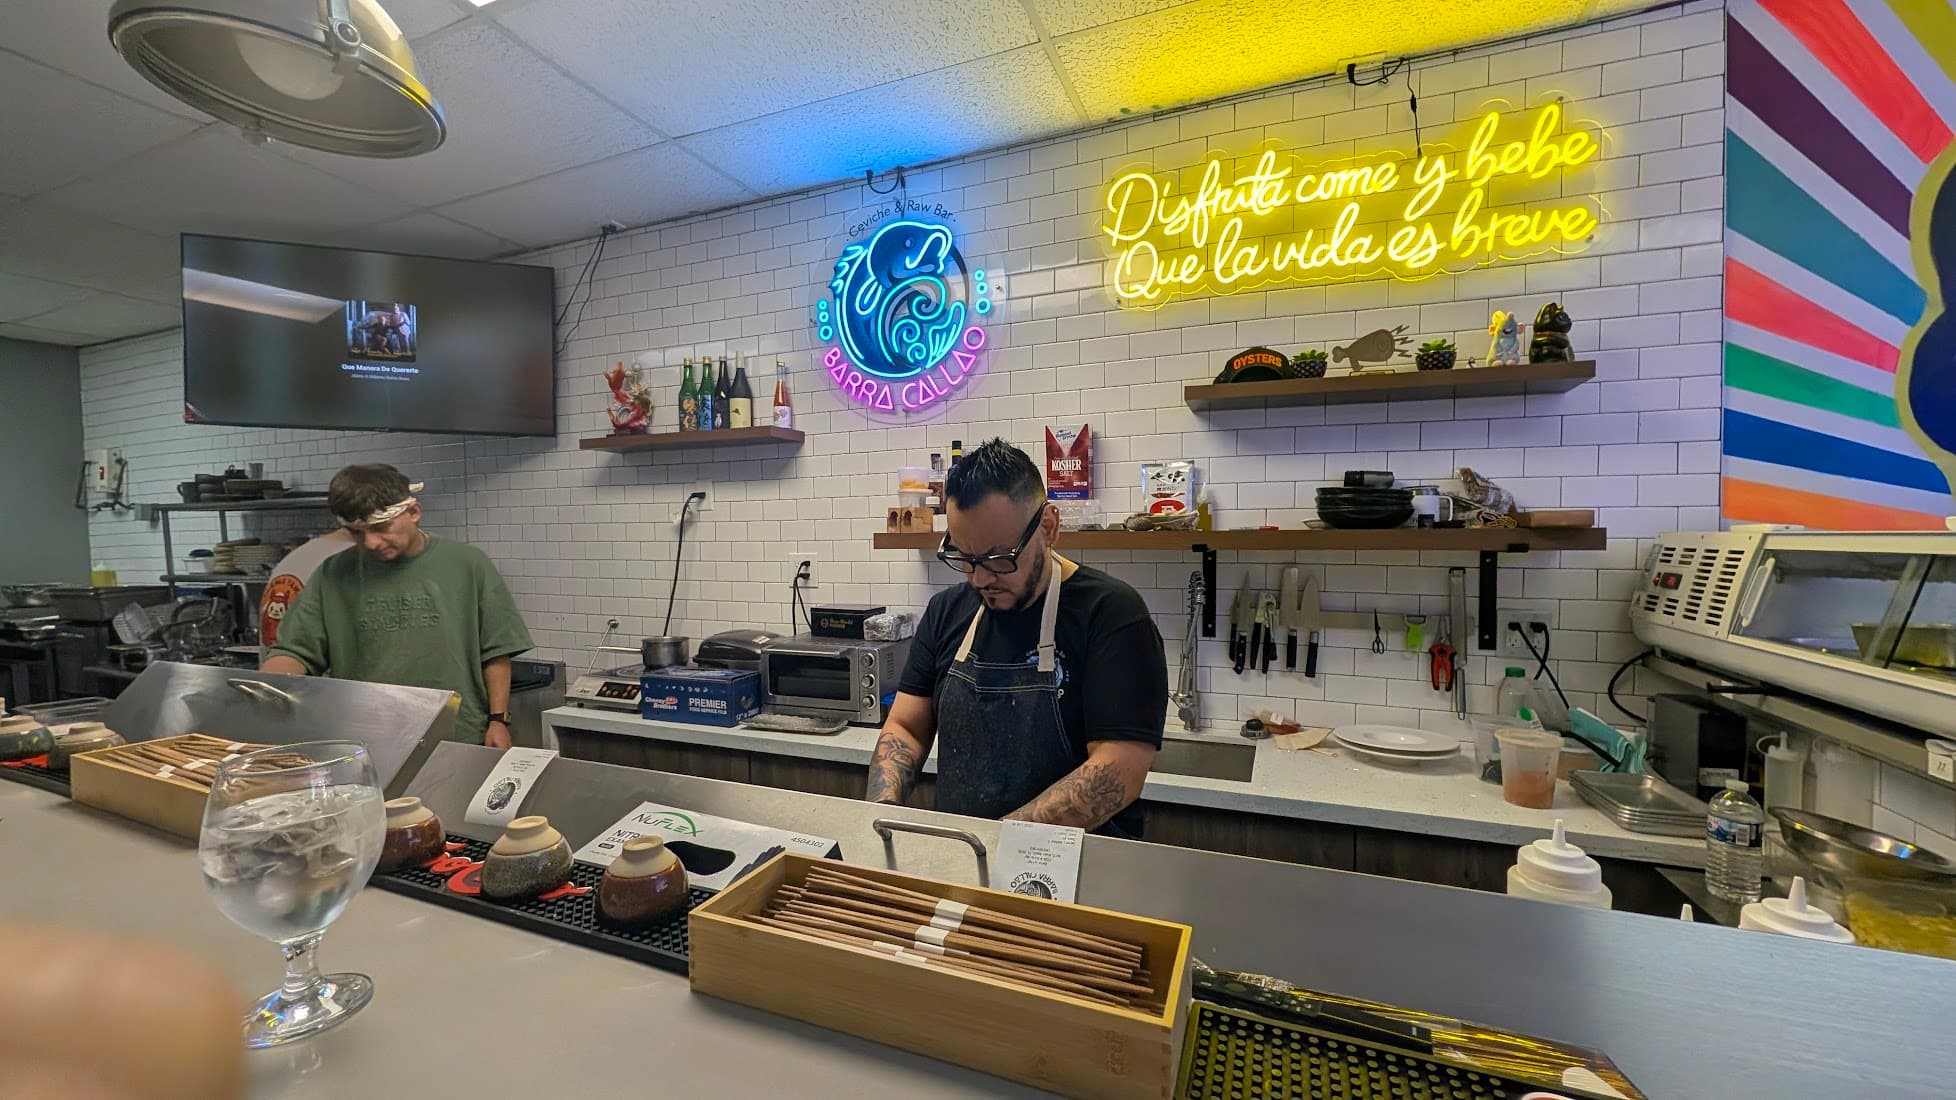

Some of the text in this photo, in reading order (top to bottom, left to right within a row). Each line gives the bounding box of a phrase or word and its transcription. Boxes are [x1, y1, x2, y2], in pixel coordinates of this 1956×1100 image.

[1102, 103, 1597, 247] Disfruta come y bebe
[894, 200, 904, 213] &
[907, 200, 931, 212] Raw
[933, 203, 953, 220] Bar
[1113, 187, 1598, 299] Que la vida es breve
[341, 363, 355, 371] Que
[356, 364, 380, 372] Manera
[824, 326, 985, 409] BARRA CALLAO
[1232, 352, 1283, 371] OYSTERS
[1051, 459, 1082, 471] KOSHER
[688, 697, 727, 709] PREMIER
